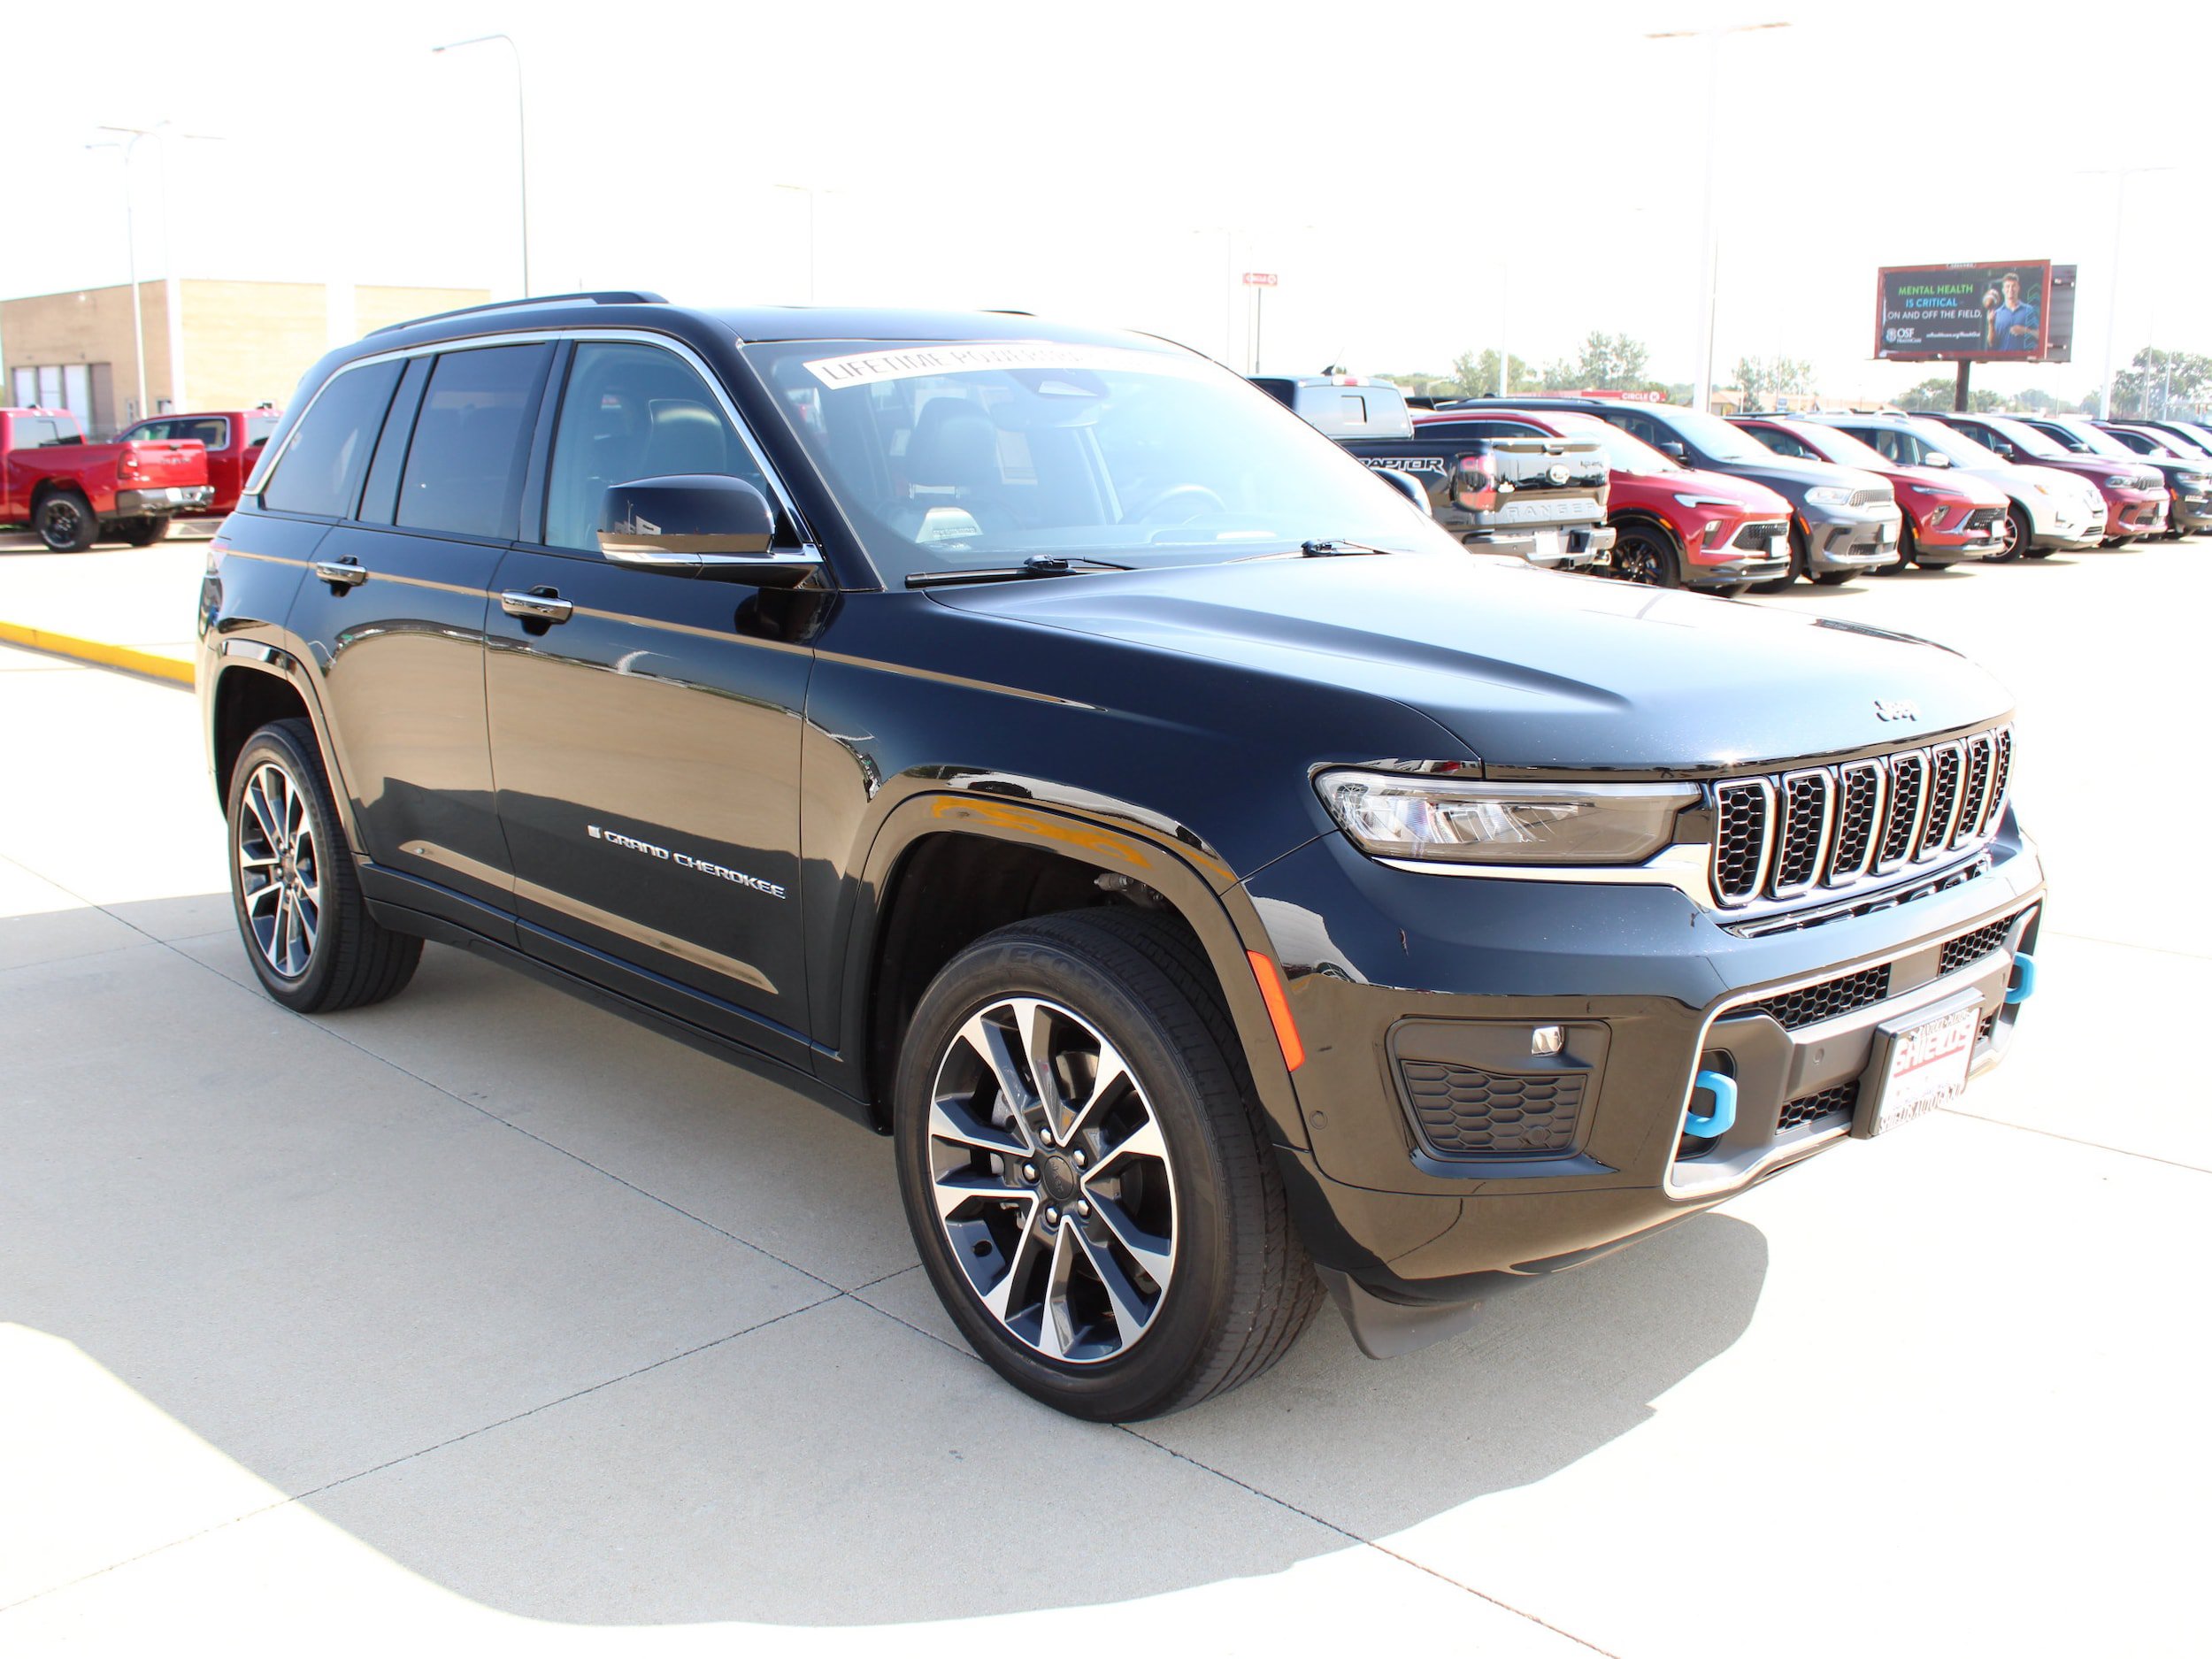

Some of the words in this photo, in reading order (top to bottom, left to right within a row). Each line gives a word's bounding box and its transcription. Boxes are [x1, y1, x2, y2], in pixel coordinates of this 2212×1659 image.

[1898, 286, 1935, 296] MENTAL
[1937, 284, 1973, 295] HEALTH
[1905, 298, 1914, 308] IS
[1916, 297, 1958, 308] CRITICAL
[1901, 311, 1920, 319] AND
[1957, 310, 1982, 319] FIELD.
[1897, 327, 1915, 338] OSF
[822, 351, 945, 379] LIFETIME
[1622, 392, 1648, 401] CIRCLE
[1507, 502, 1600, 524] RANGER
[1874, 700, 1919, 721] Jeep
[603, 830, 669, 860] GRAND
[672, 852, 787, 900] CHEROKEE
[1895, 1021, 1972, 1070] SHIELDS
